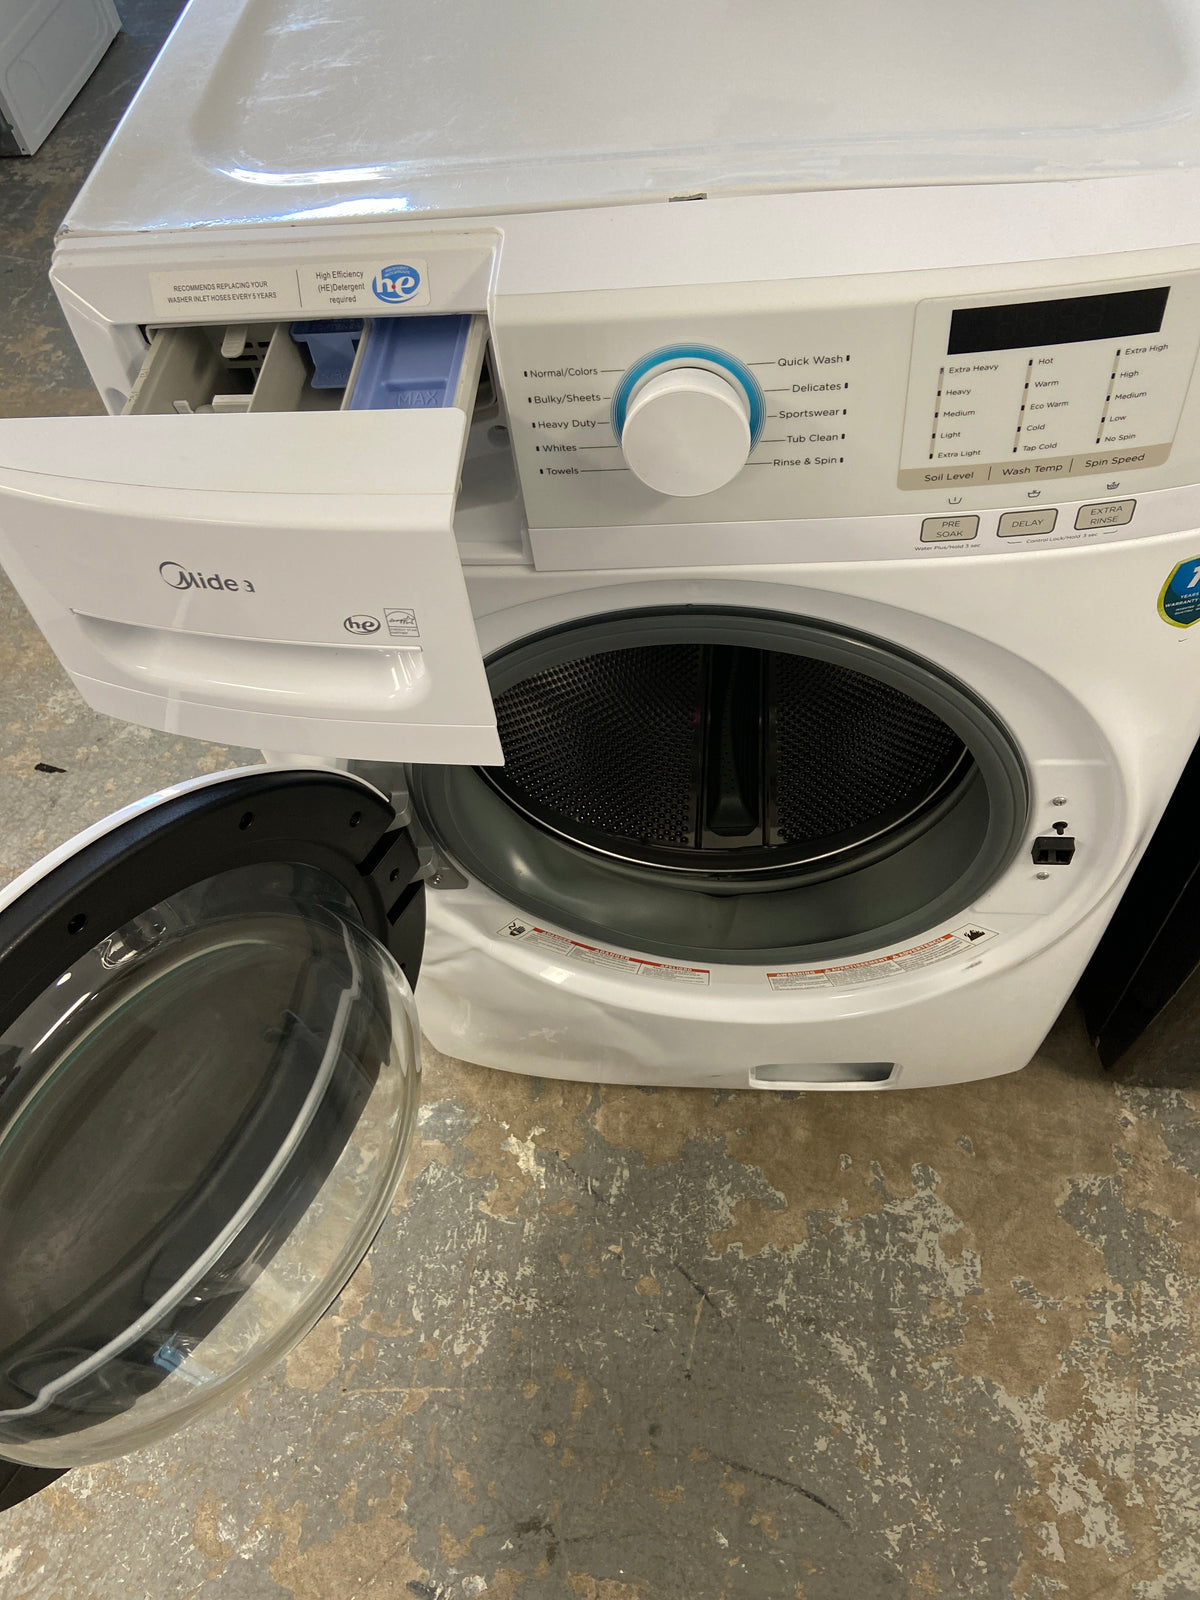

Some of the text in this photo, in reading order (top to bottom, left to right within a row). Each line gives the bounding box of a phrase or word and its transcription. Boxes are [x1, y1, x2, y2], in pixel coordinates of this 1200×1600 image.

[315, 270, 364, 281] High Efficiency
[173, 284, 216, 292] RECOMMENDS
[216, 282, 250, 290] REPLACING
[318, 283, 365, 293] (HE)Detergent
[329, 295, 356, 304] required
[1125, 344, 1169, 355] Extra High
[777, 354, 843, 367] Quick Wash
[530, 367, 598, 378] Normal/Colors
[948, 364, 999, 374] Extra Heavy
[1119, 370, 1139, 378] High
[792, 383, 842, 393] Delicates
[1035, 380, 1059, 388] Warm
[397, 391, 438, 405] MAX
[534, 393, 601, 405] Bulky/Sheets
[1114, 391, 1147, 400] Medium
[1047, 400, 1069, 409] Warm
[779, 409, 840, 419] Sportswear
[537, 419, 597, 430] Heavy Duty
[1026, 424, 1046, 432] Cold
[787, 434, 839, 443] Tub Clean
[940, 431, 961, 439] Light
[1118, 433, 1136, 441] Spin
[542, 444, 577, 452] Whites
[1038, 442, 1058, 450] Cold
[960, 450, 981, 458] Light
[773, 456, 837, 467] Rinse & Spin
[1085, 453, 1145, 468] Spin Speed
[546, 467, 579, 476] Towels
[1002, 464, 1063, 476] Wash Temp
[924, 472, 974, 482] Soil Level
[1090, 505, 1123, 516] EXTRA
[942, 520, 961, 528] PRE
[1011, 519, 1044, 528] DELAY
[1090, 516, 1119, 525] RINSE
[1165, 598, 1199, 608] WARRANTY
[346, 615, 378, 633] he
[600, 949, 630, 961] DANGER
